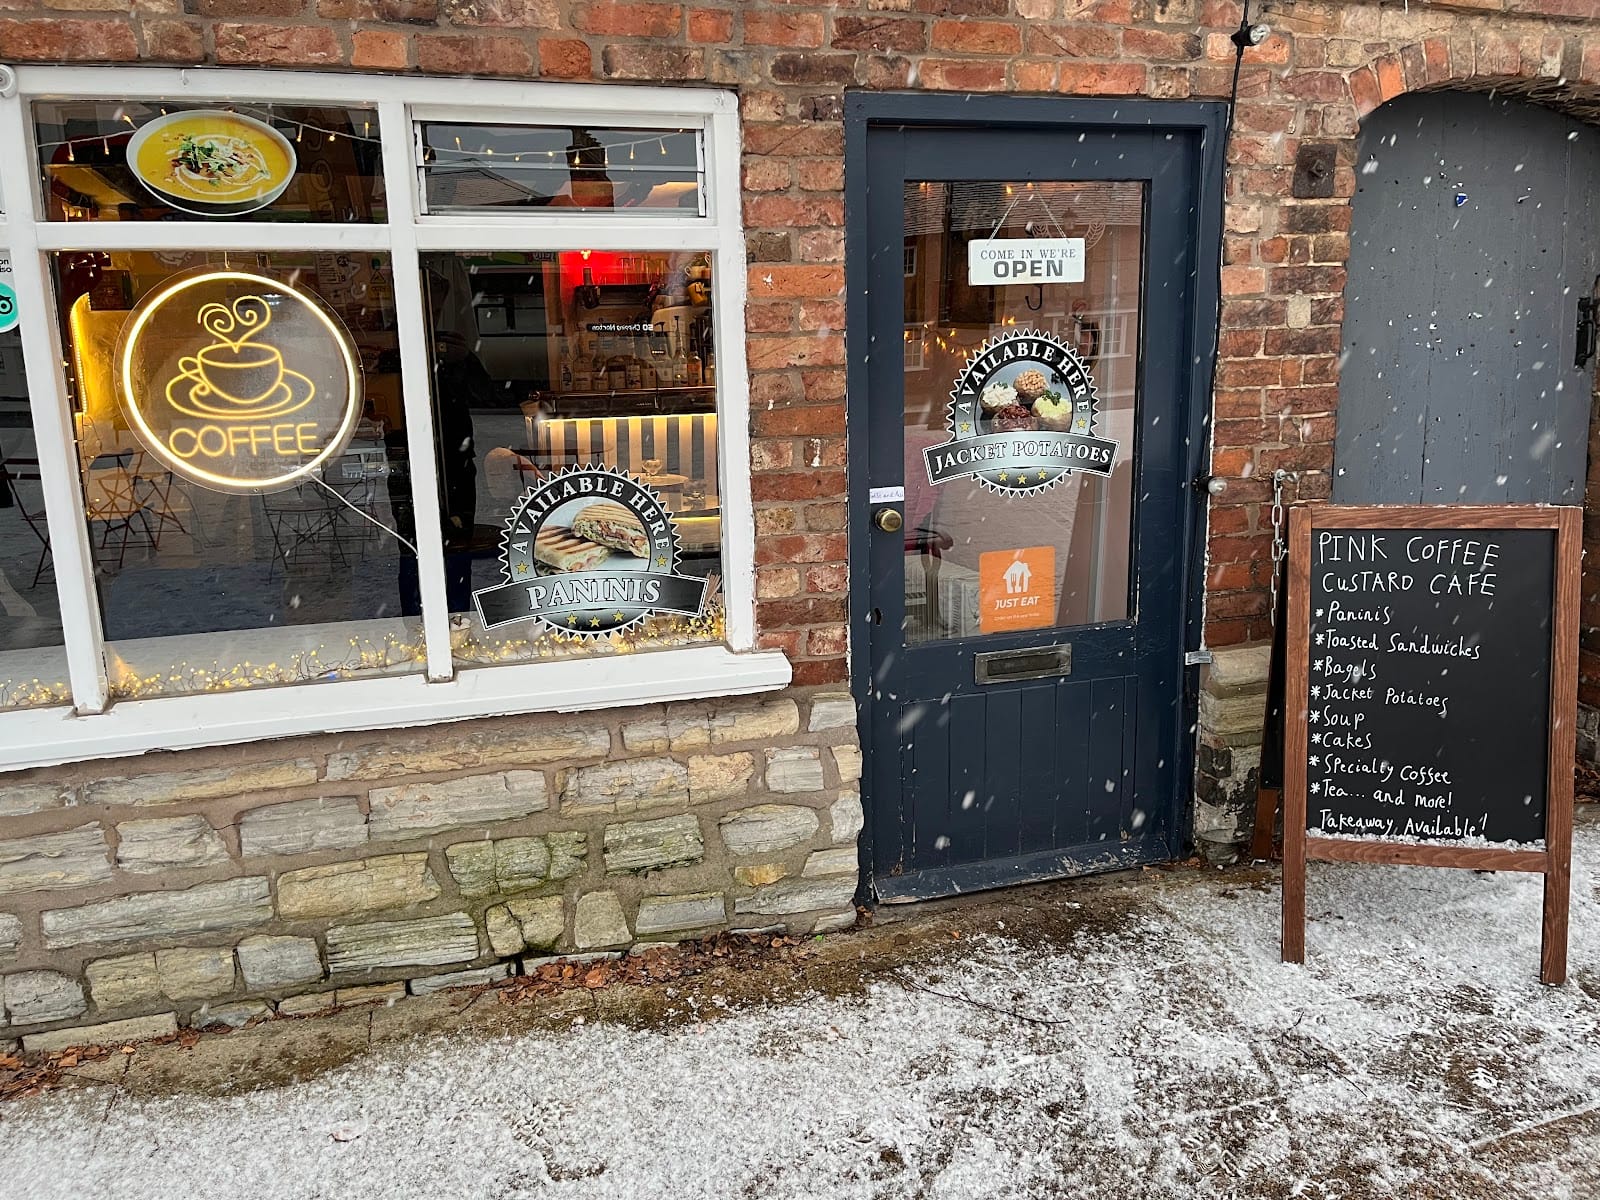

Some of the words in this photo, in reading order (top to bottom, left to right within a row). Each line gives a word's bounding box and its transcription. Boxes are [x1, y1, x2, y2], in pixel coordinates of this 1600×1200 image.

[980, 249, 1015, 260] COME
[1021, 249, 1033, 259] IN
[1040, 248, 1076, 258] WE'RE
[993, 259, 1063, 278] OPEN
[958, 341, 1055, 416] AVAILABLE
[1056, 355, 1090, 413] HERE
[168, 423, 321, 458] COFFEE
[934, 441, 1008, 475] JACKET
[1012, 440, 1111, 464] POTATOES
[511, 476, 625, 555] AVAILABLE
[627, 491, 671, 551] HERE
[1319, 531, 1388, 564] PINK
[526, 577, 661, 611] PANINIS
[1429, 573, 1497, 596] CAFE
[994, 597, 1020, 610] JUST
[1021, 595, 1040, 606] EAT
[1325, 629, 1379, 651] Toasted
[1387, 633, 1481, 660] Sandwiches
[1324, 656, 1377, 681] Bagels
[1322, 683, 1374, 701] Jacket
[1385, 687, 1449, 716] Potatoes
[1323, 705, 1365, 731] Soup
[1322, 731, 1372, 750] Cakes
[1324, 753, 1394, 783] Specialty
[1400, 765, 1452, 786] Coffee
[1373, 790, 1405, 806] and
[1415, 792, 1452, 813] more!
[1320, 809, 1394, 836] Takeaway
[1404, 812, 1489, 838] Available!
